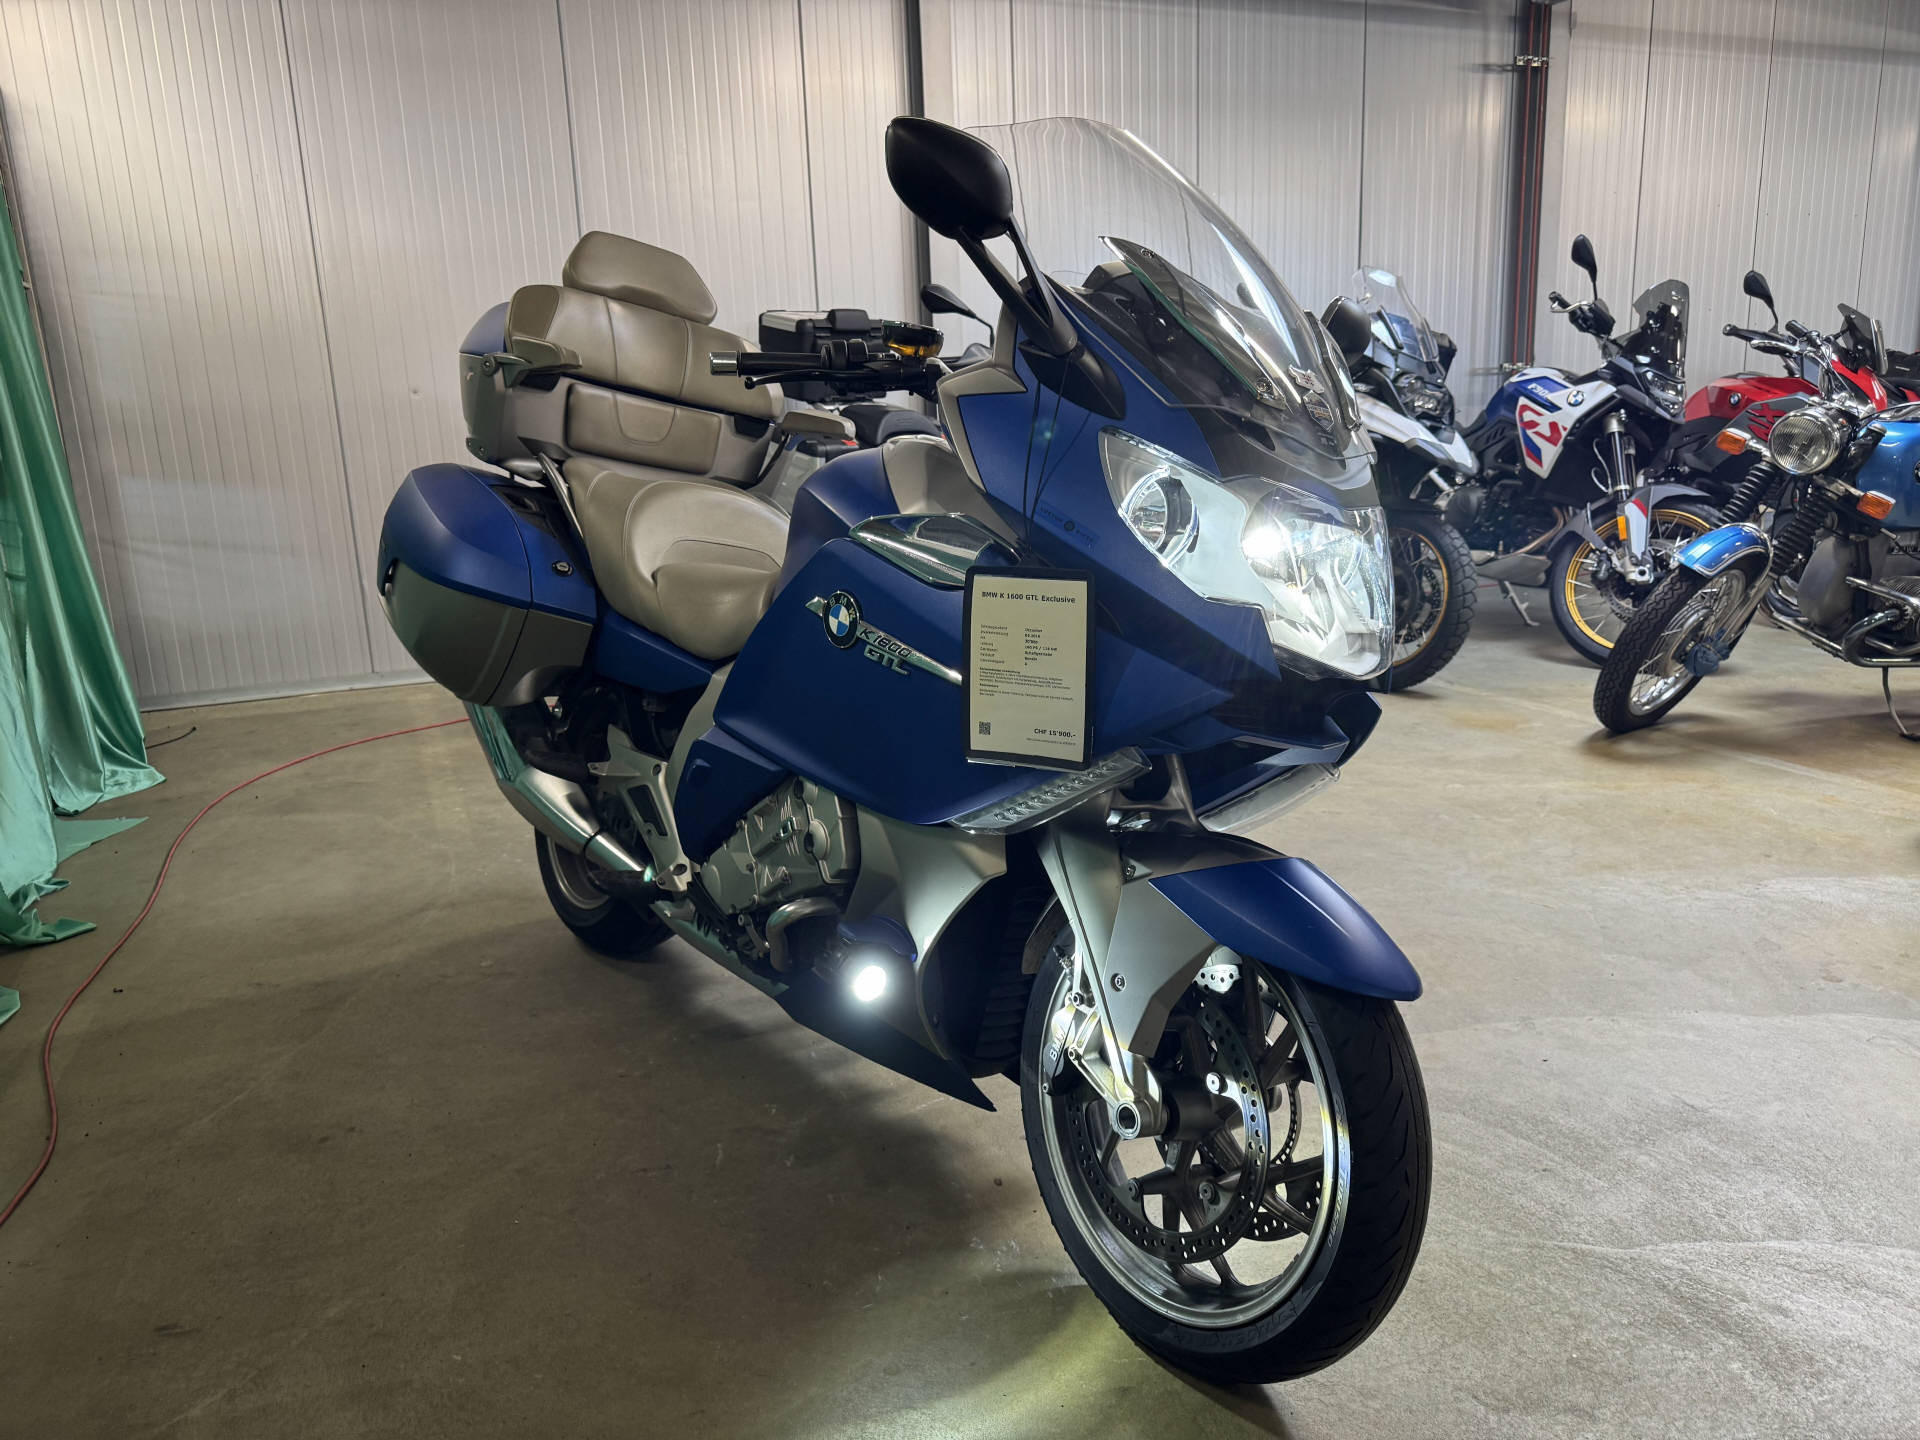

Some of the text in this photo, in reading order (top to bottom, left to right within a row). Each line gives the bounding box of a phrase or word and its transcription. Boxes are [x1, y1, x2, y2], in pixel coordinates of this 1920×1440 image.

[829, 596, 856, 621] BMW
[981, 591, 997, 599] BMW
[1041, 595, 1076, 604] Exclusive
[860, 628, 912, 658] K 1600
[864, 644, 909, 675] GTL
